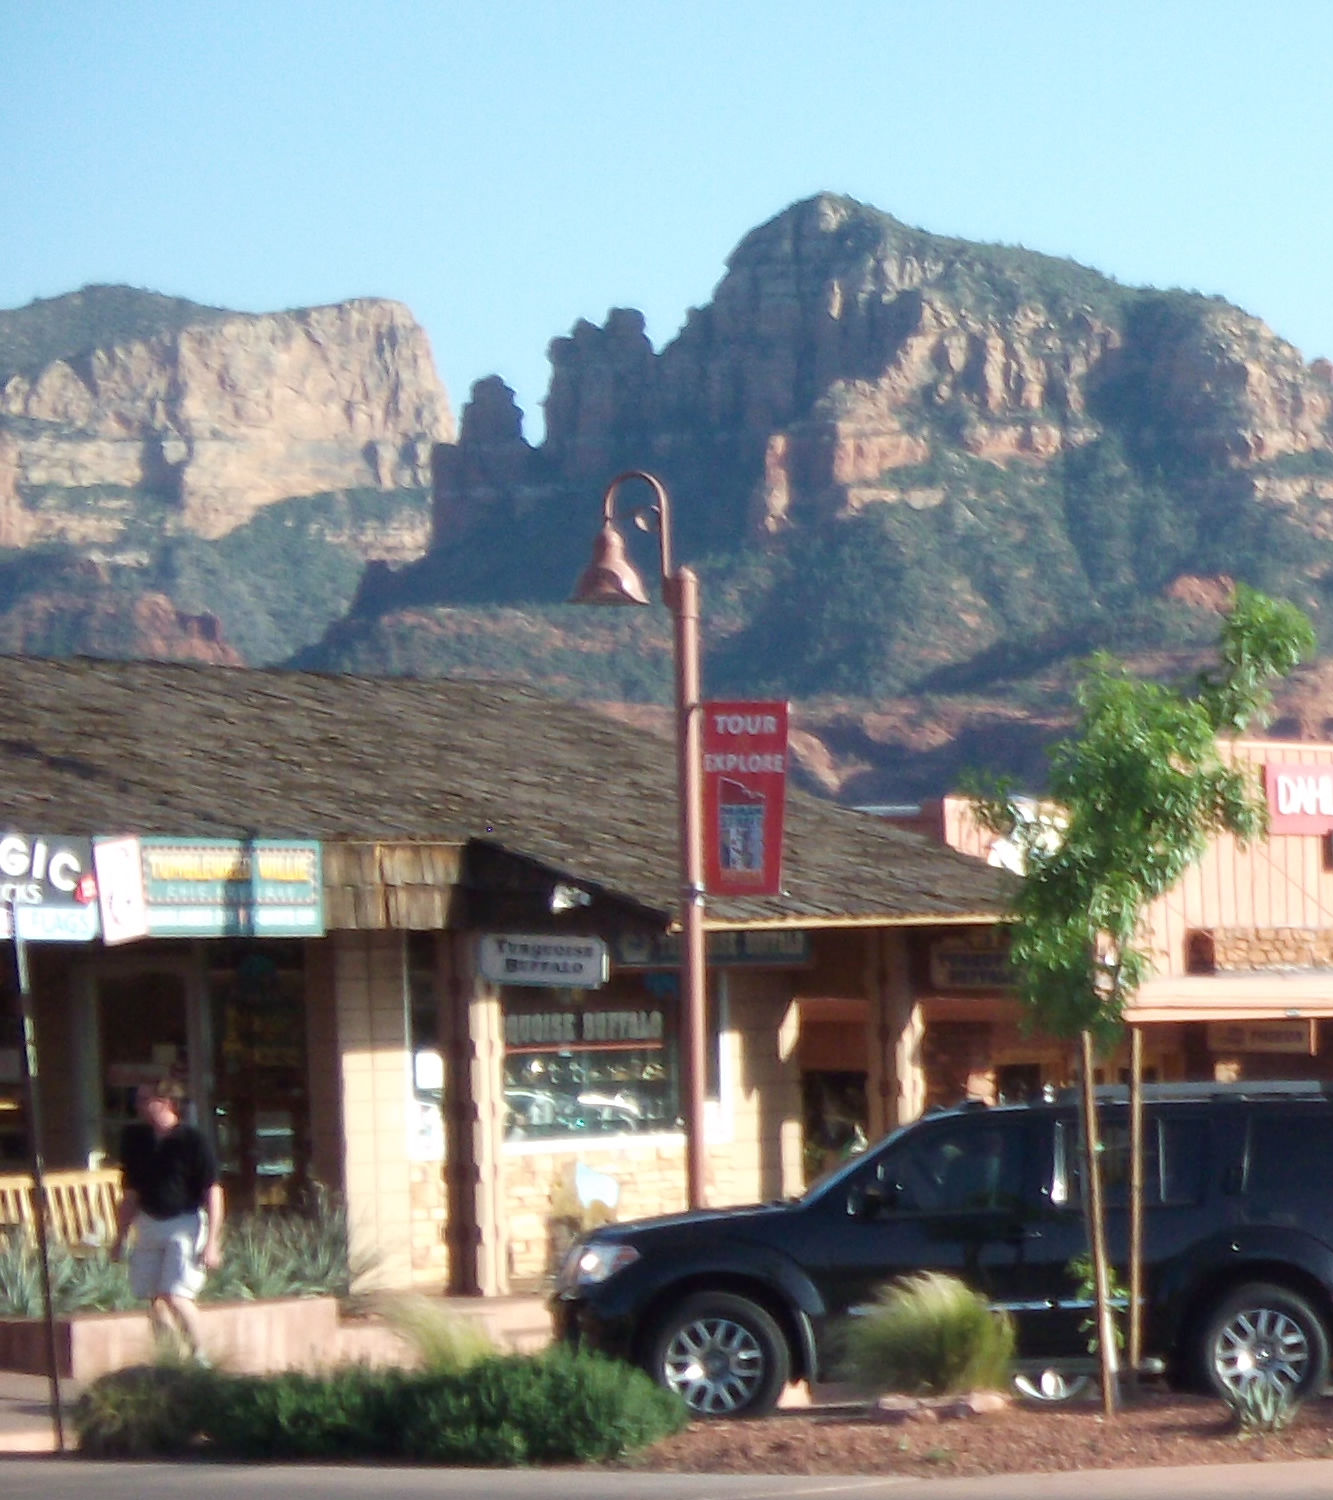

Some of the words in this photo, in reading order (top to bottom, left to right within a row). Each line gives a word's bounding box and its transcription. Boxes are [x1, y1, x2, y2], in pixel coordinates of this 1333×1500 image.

[713, 714, 777, 736] TOUR
[703, 753, 785, 774] EXPLORE
[496, 938, 594, 958] TURQUOISE
[505, 957, 584, 975] BUFFALO
